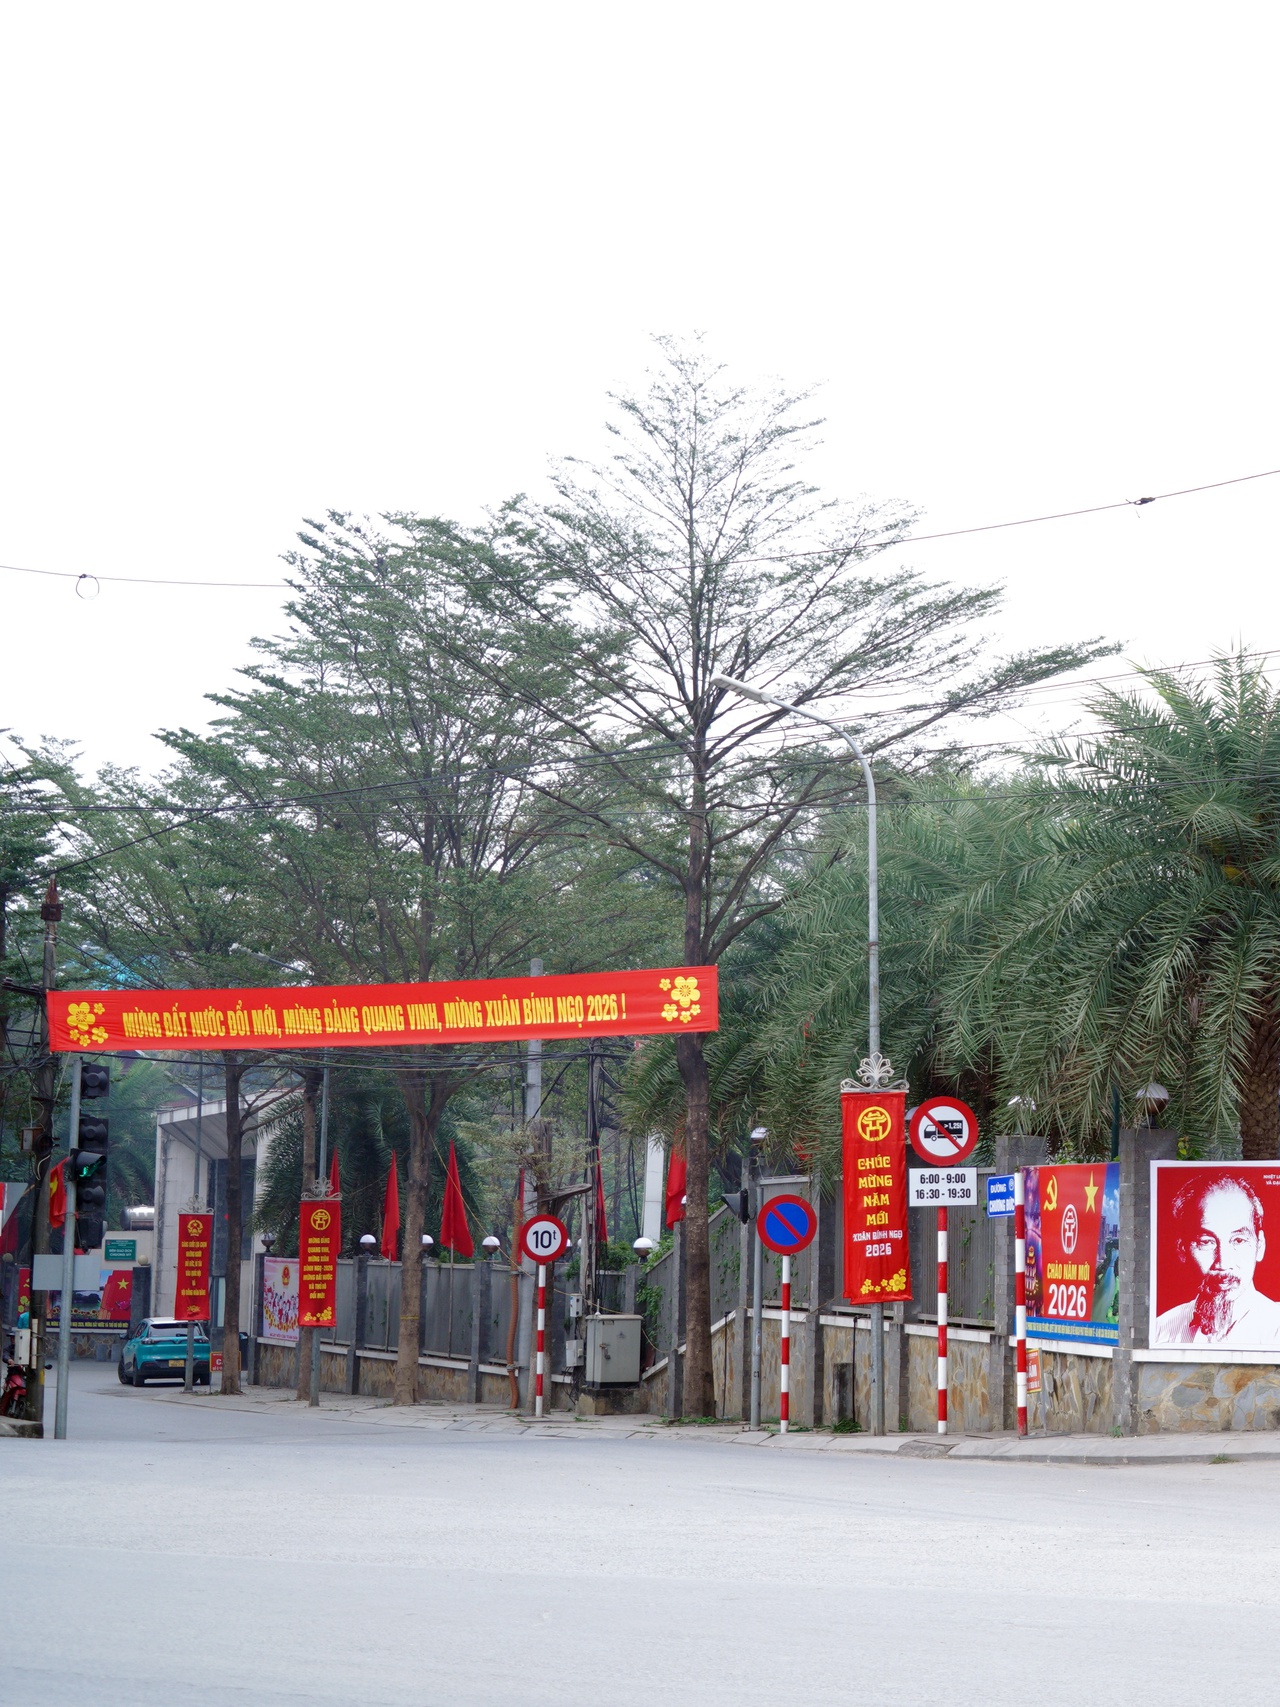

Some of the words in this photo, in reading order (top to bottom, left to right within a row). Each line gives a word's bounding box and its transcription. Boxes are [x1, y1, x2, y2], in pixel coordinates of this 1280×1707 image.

[122, 1007, 162, 1038] MỪNG
[163, 1003, 188, 1037] ĐẤT
[190, 1006, 226, 1037] NƯỚC
[227, 1000, 250, 1036] ĐỔI
[251, 1004, 282, 1038] MỚI,
[283, 1003, 322, 1034] MỪNG
[324, 999, 360, 1033] ĐẢNG
[362, 1005, 405, 1035] QUANG
[407, 1003, 442, 1032] VINH,
[444, 996, 483, 1028] MỪNG
[485, 994, 521, 1027] XUÂN
[523, 992, 554, 1025] BÍNH
[557, 995, 584, 1028] NGỌ
[587, 993, 618, 1022] 2026
[857, 1154, 891, 1170] CHÚC
[858, 1174, 893, 1189] MỪNG
[920, 1173, 940, 1184] 6:00
[946, 1173, 966, 1184] 9:00
[863, 1192, 890, 1207] NĂM
[947, 1188, 971, 1199] 19:30
[866, 1210, 889, 1226] MỚI
[533, 1230, 556, 1248] 10t
[865, 1243, 892, 1257] 2026
[1047, 1260, 1063, 1279] CHÀO
[1063, 1260, 1077, 1280] NĂM
[1078, 1261, 1090, 1281] MỚI
[1048, 1283, 1087, 1317] 2026
